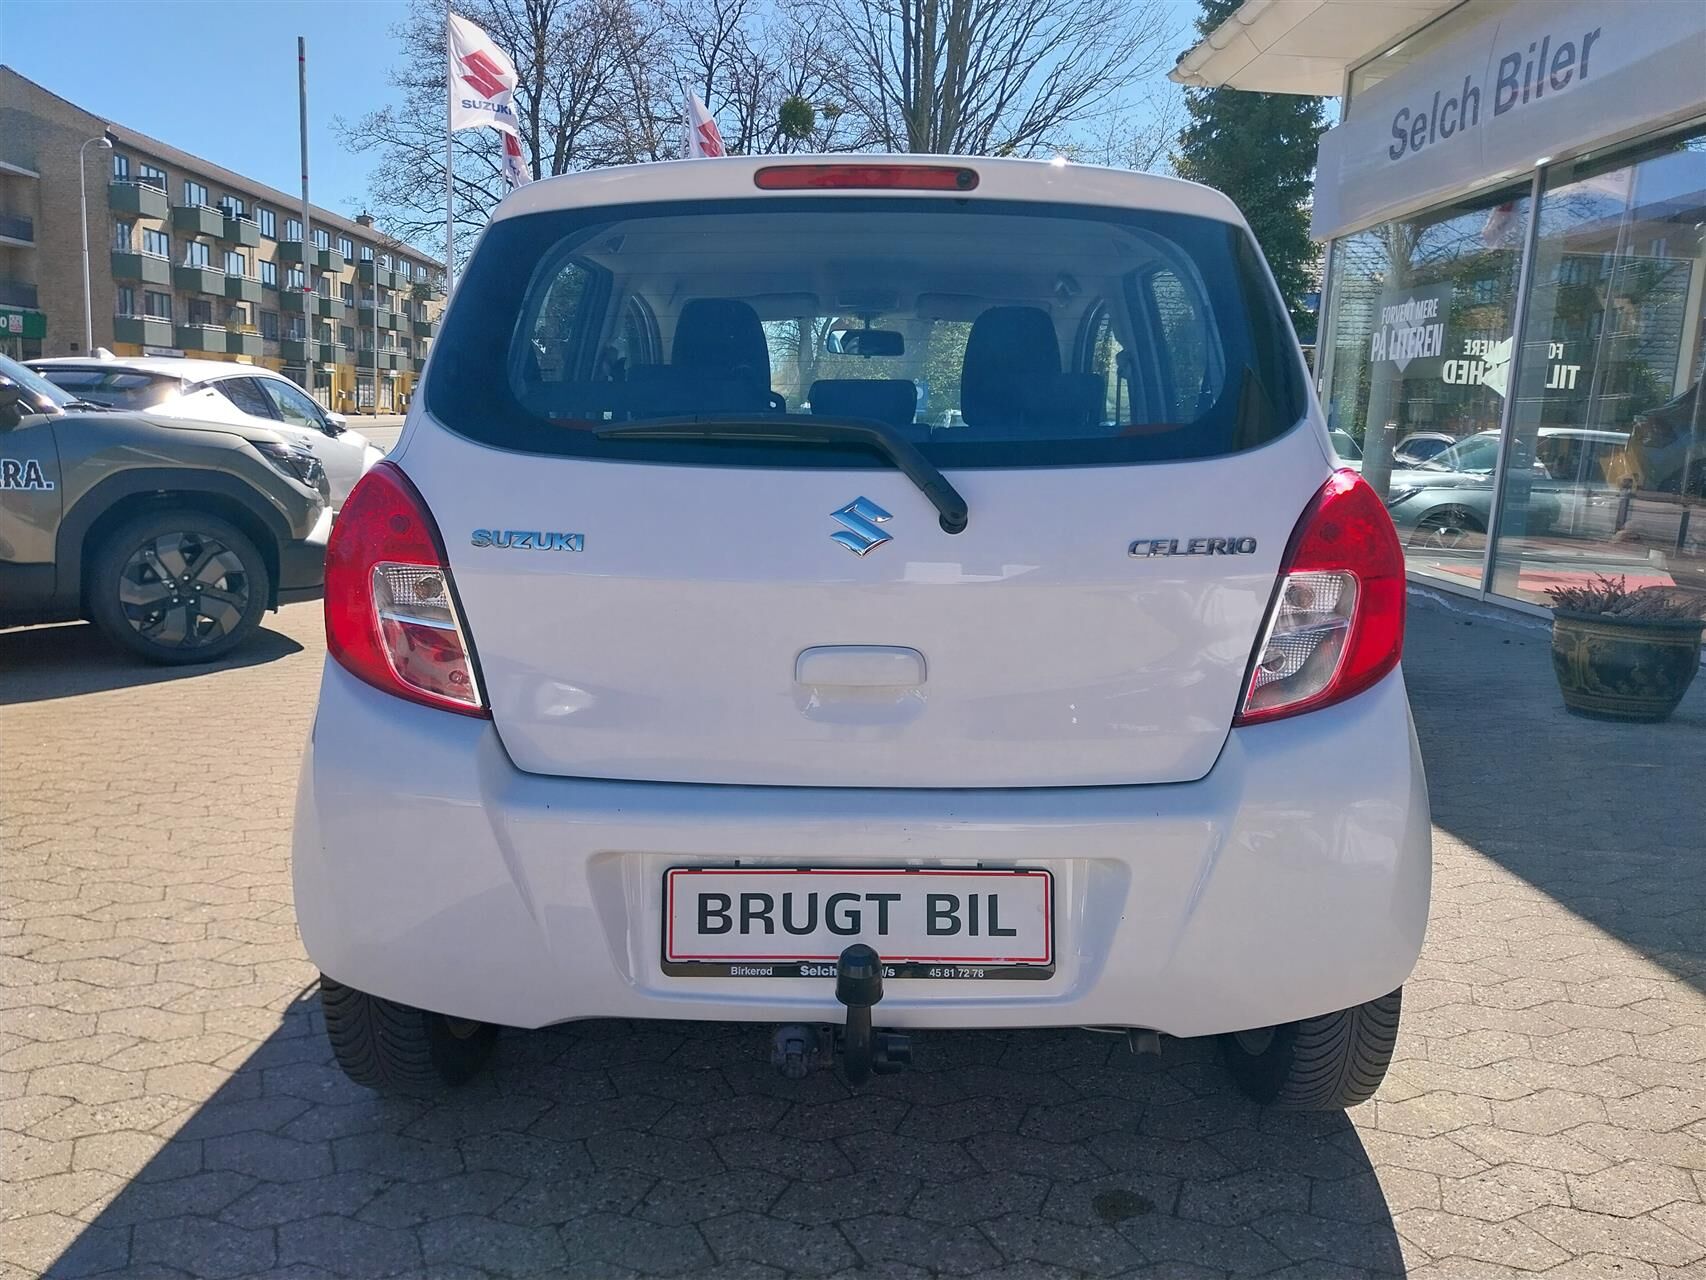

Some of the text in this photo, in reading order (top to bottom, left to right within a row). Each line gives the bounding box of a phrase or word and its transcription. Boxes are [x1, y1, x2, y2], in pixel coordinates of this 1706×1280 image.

[461, 98, 512, 116] SUZUKI
[1389, 27, 1602, 161] Selch Biler
[1381, 298, 1439, 325] FORVENT MERE
[1370, 323, 1444, 362] PÅ LITEREN
[0, 458, 54, 490] RA.
[471, 528, 585, 553] SUZUKI
[1127, 536, 1257, 557] CELERIO
[697, 892, 1017, 937] BRUGT BIL
[730, 966, 773, 977] Birkerød
[799, 965, 837, 977] Selch
[929, 968, 942, 978] 45
[943, 968, 955, 978] 81
[957, 968, 970, 978] 72
[971, 968, 985, 979] 78
